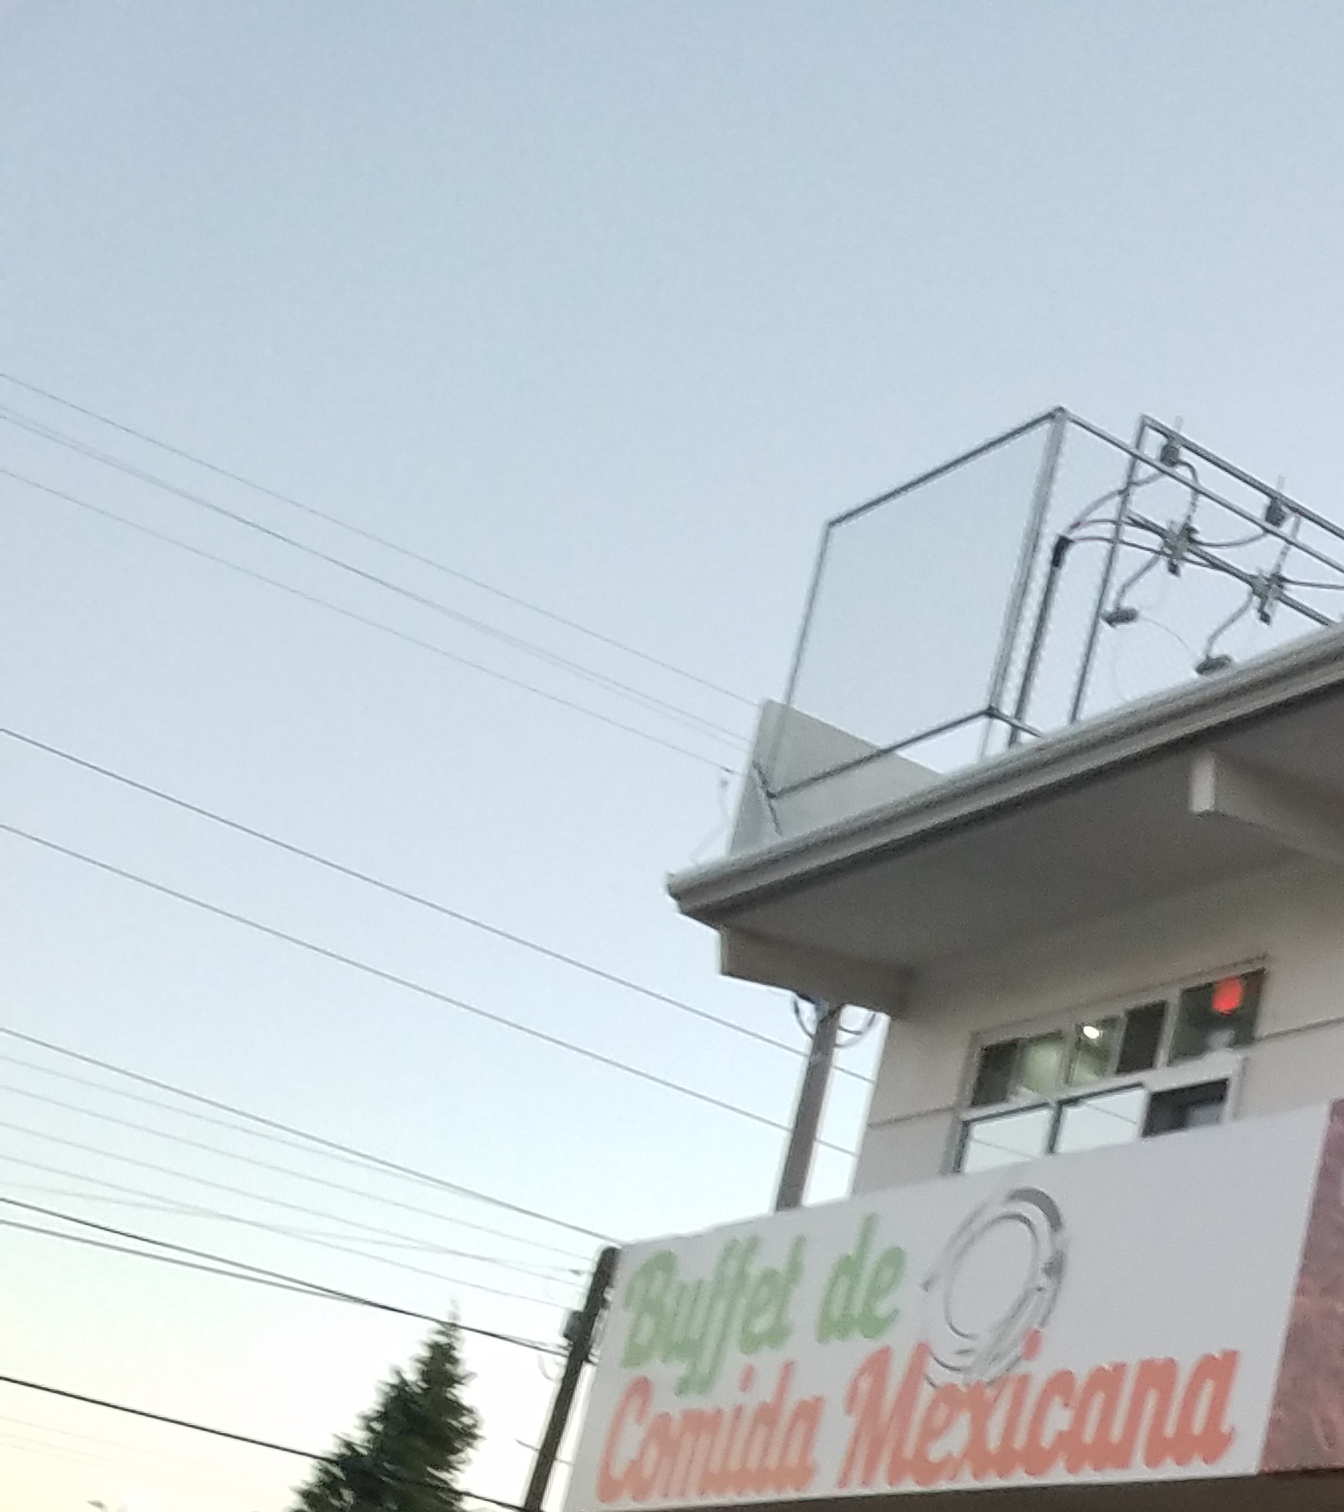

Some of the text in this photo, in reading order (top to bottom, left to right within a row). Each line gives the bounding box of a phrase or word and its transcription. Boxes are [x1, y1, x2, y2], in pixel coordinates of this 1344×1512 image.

[620, 1212, 907, 1397] Buffet de
[596, 1327, 1242, 1503] Comida Mexicana
